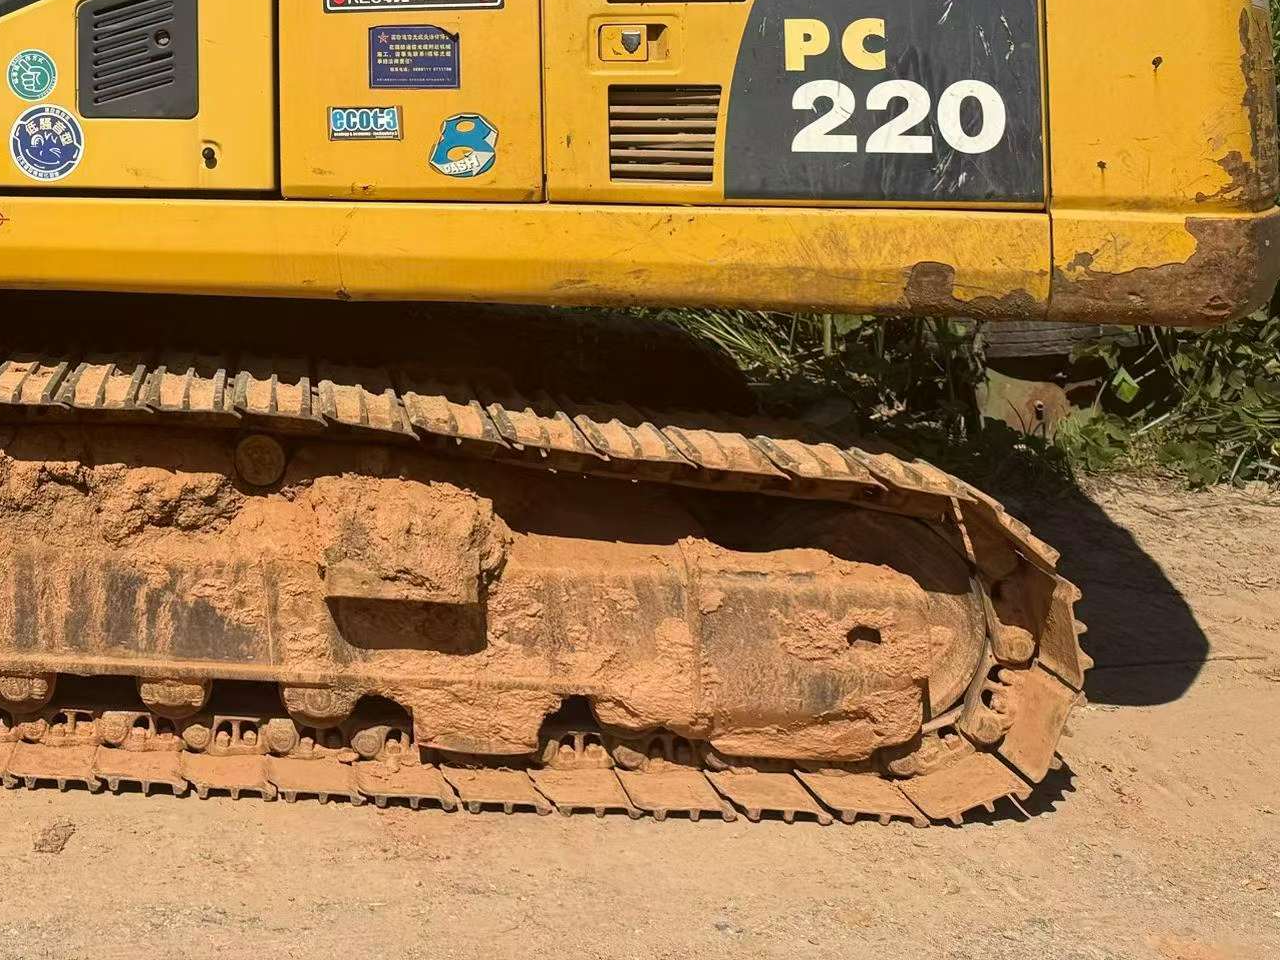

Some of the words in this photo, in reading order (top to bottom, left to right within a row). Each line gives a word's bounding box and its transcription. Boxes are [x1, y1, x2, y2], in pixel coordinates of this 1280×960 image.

[784, 17, 887, 71] PC
[331, 108, 398, 132] ecot3
[791, 79, 1007, 154] 220
